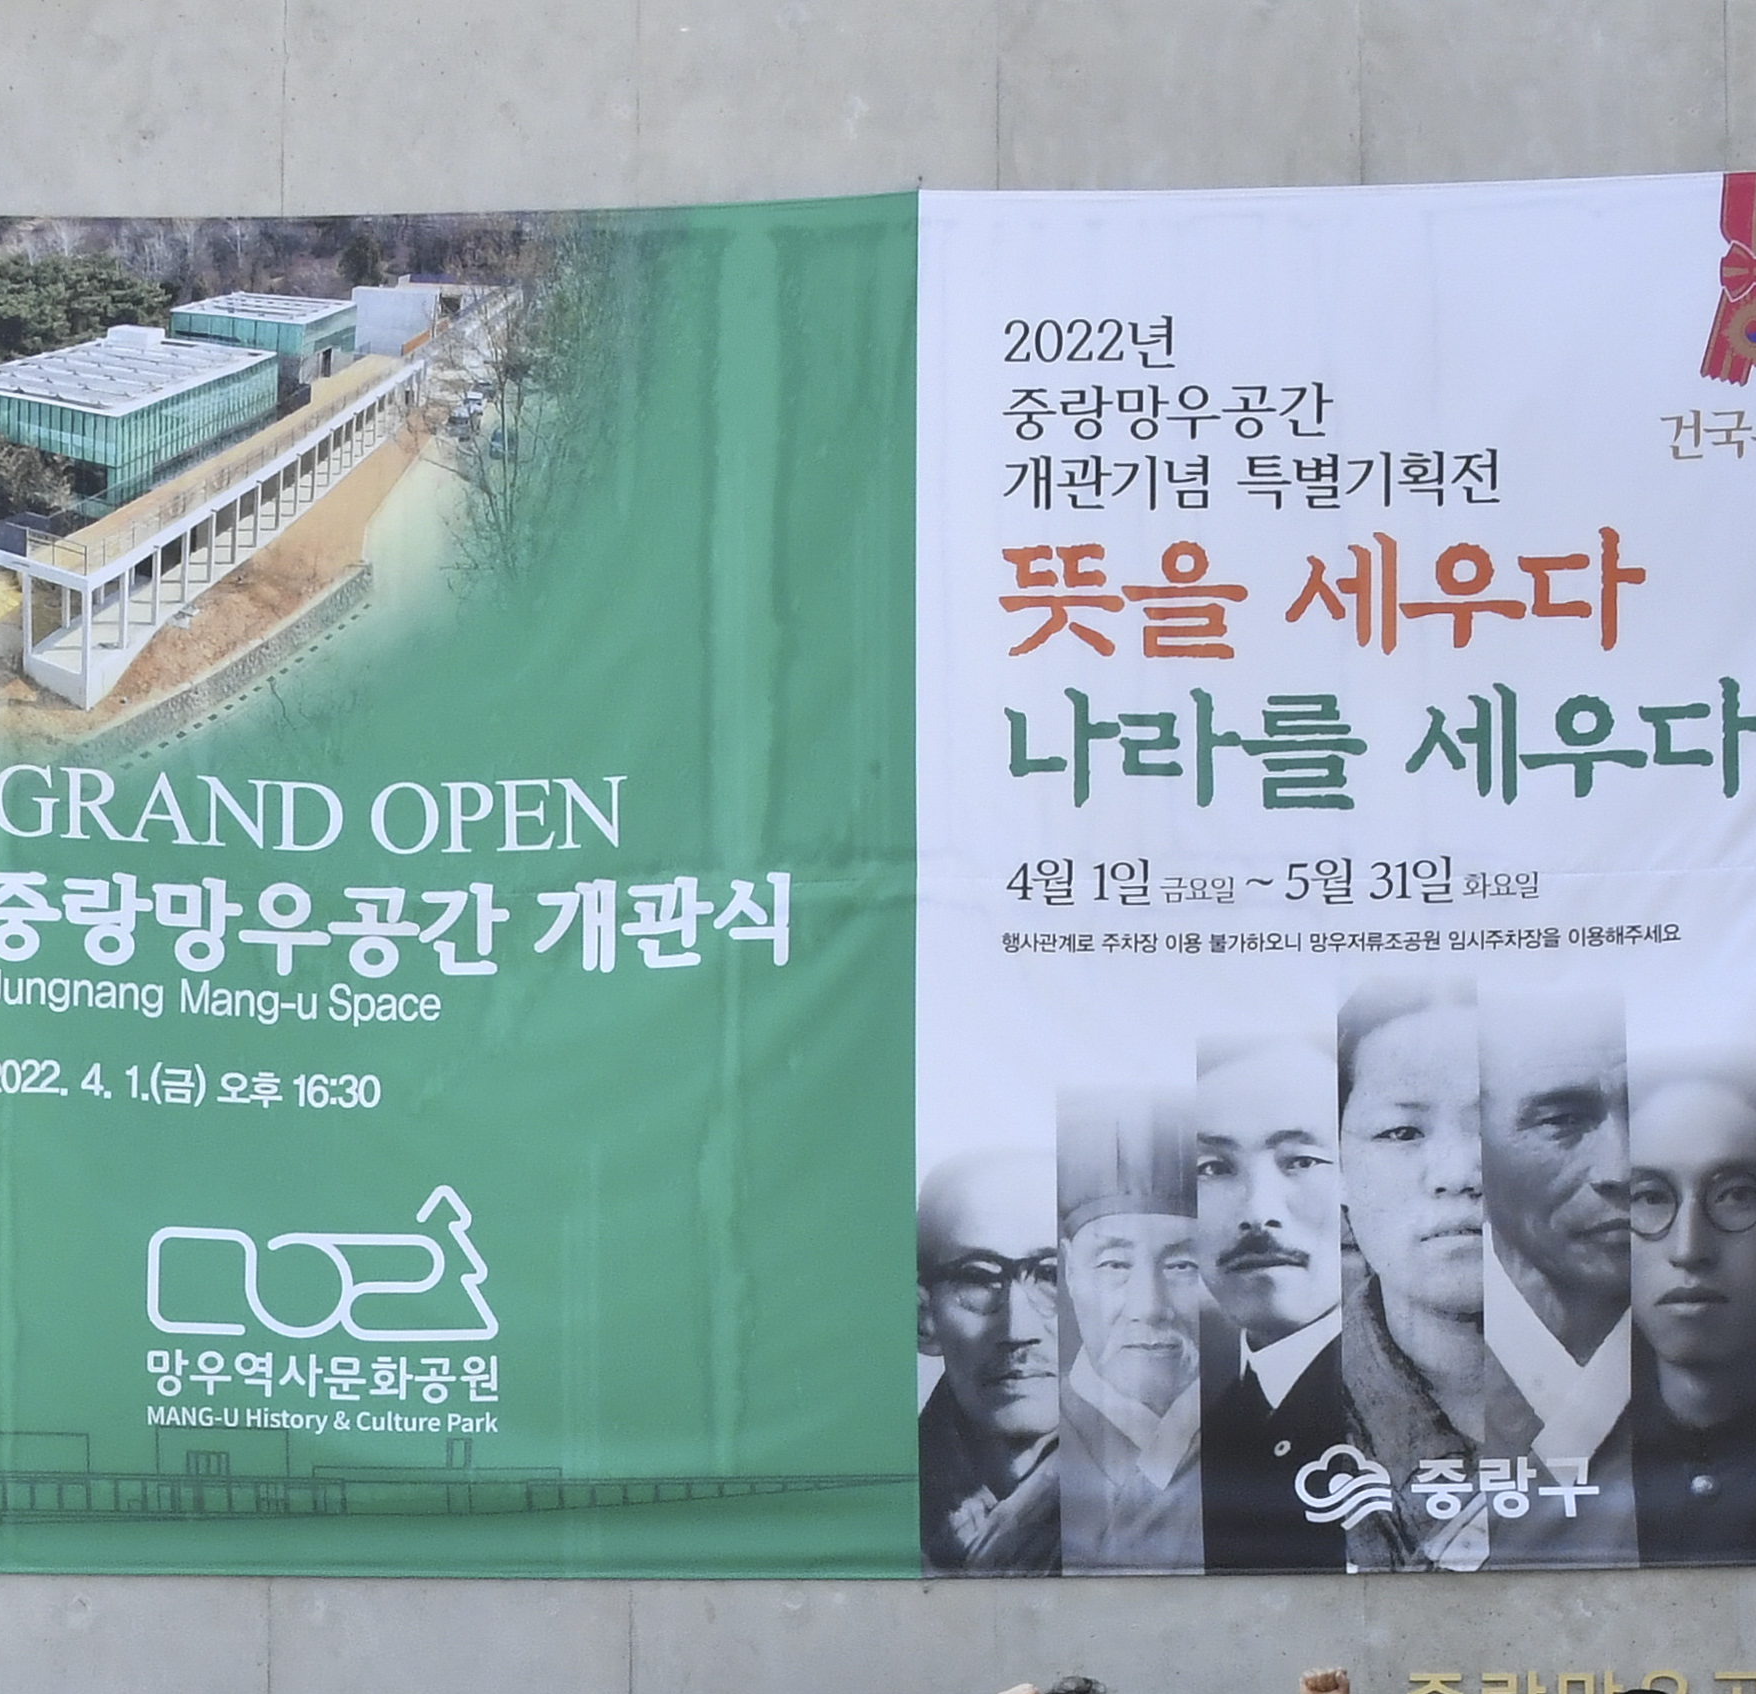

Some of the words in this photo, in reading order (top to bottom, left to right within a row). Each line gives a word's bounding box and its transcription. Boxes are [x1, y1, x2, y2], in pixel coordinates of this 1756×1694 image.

[1002, 313, 1177, 371] 2022년
[1001, 382, 1335, 443] 중랑망우공간
[1001, 452, 1211, 511] 개관기념
[1236, 446, 1502, 511] 특별기획전
[997, 538, 1249, 661] 뜻을
[1284, 524, 1647, 656] 세우다
[1003, 686, 1368, 811] 나라를
[369, 773, 627, 855] OPEN
[1005, 856, 1076, 907] 4월
[1091, 856, 1152, 907] 1일
[1159, 875, 1236, 905] 금요일
[1284, 856, 1355, 907] 5월
[1368, 854, 1454, 905] 31일
[1461, 869, 1541, 901] 화요일
[534, 870, 793, 974] 개관식
[1001, 930, 1095, 955] 행사관계로
[1102, 930, 1157, 955] 주차장
[1165, 930, 1202, 954] 이용
[1208, 931, 1303, 954] 불가하오니
[1309, 928, 1441, 954] 망우저류조공원
[1447, 926, 1561, 952] 임시주차장을
[1566, 921, 1682, 948] 이용해주세요
[180, 978, 317, 1025] Mang-u
[328, 983, 441, 1027] Space
[80, 1063, 112, 1098] 4.
[125, 1061, 205, 1107] 1.(금)
[217, 1071, 282, 1108] 오후
[293, 1074, 381, 1108] 16:30
[147, 1349, 499, 1404] 망우역사문화공원
[147, 1406, 239, 1427] MANG-U
[246, 1407, 328, 1434] History
[333, 1411, 350, 1431] &
[356, 1411, 441, 1433] Culture
[447, 1412, 498, 1433] Park
[1410, 1455, 1601, 1520] 중랑구
